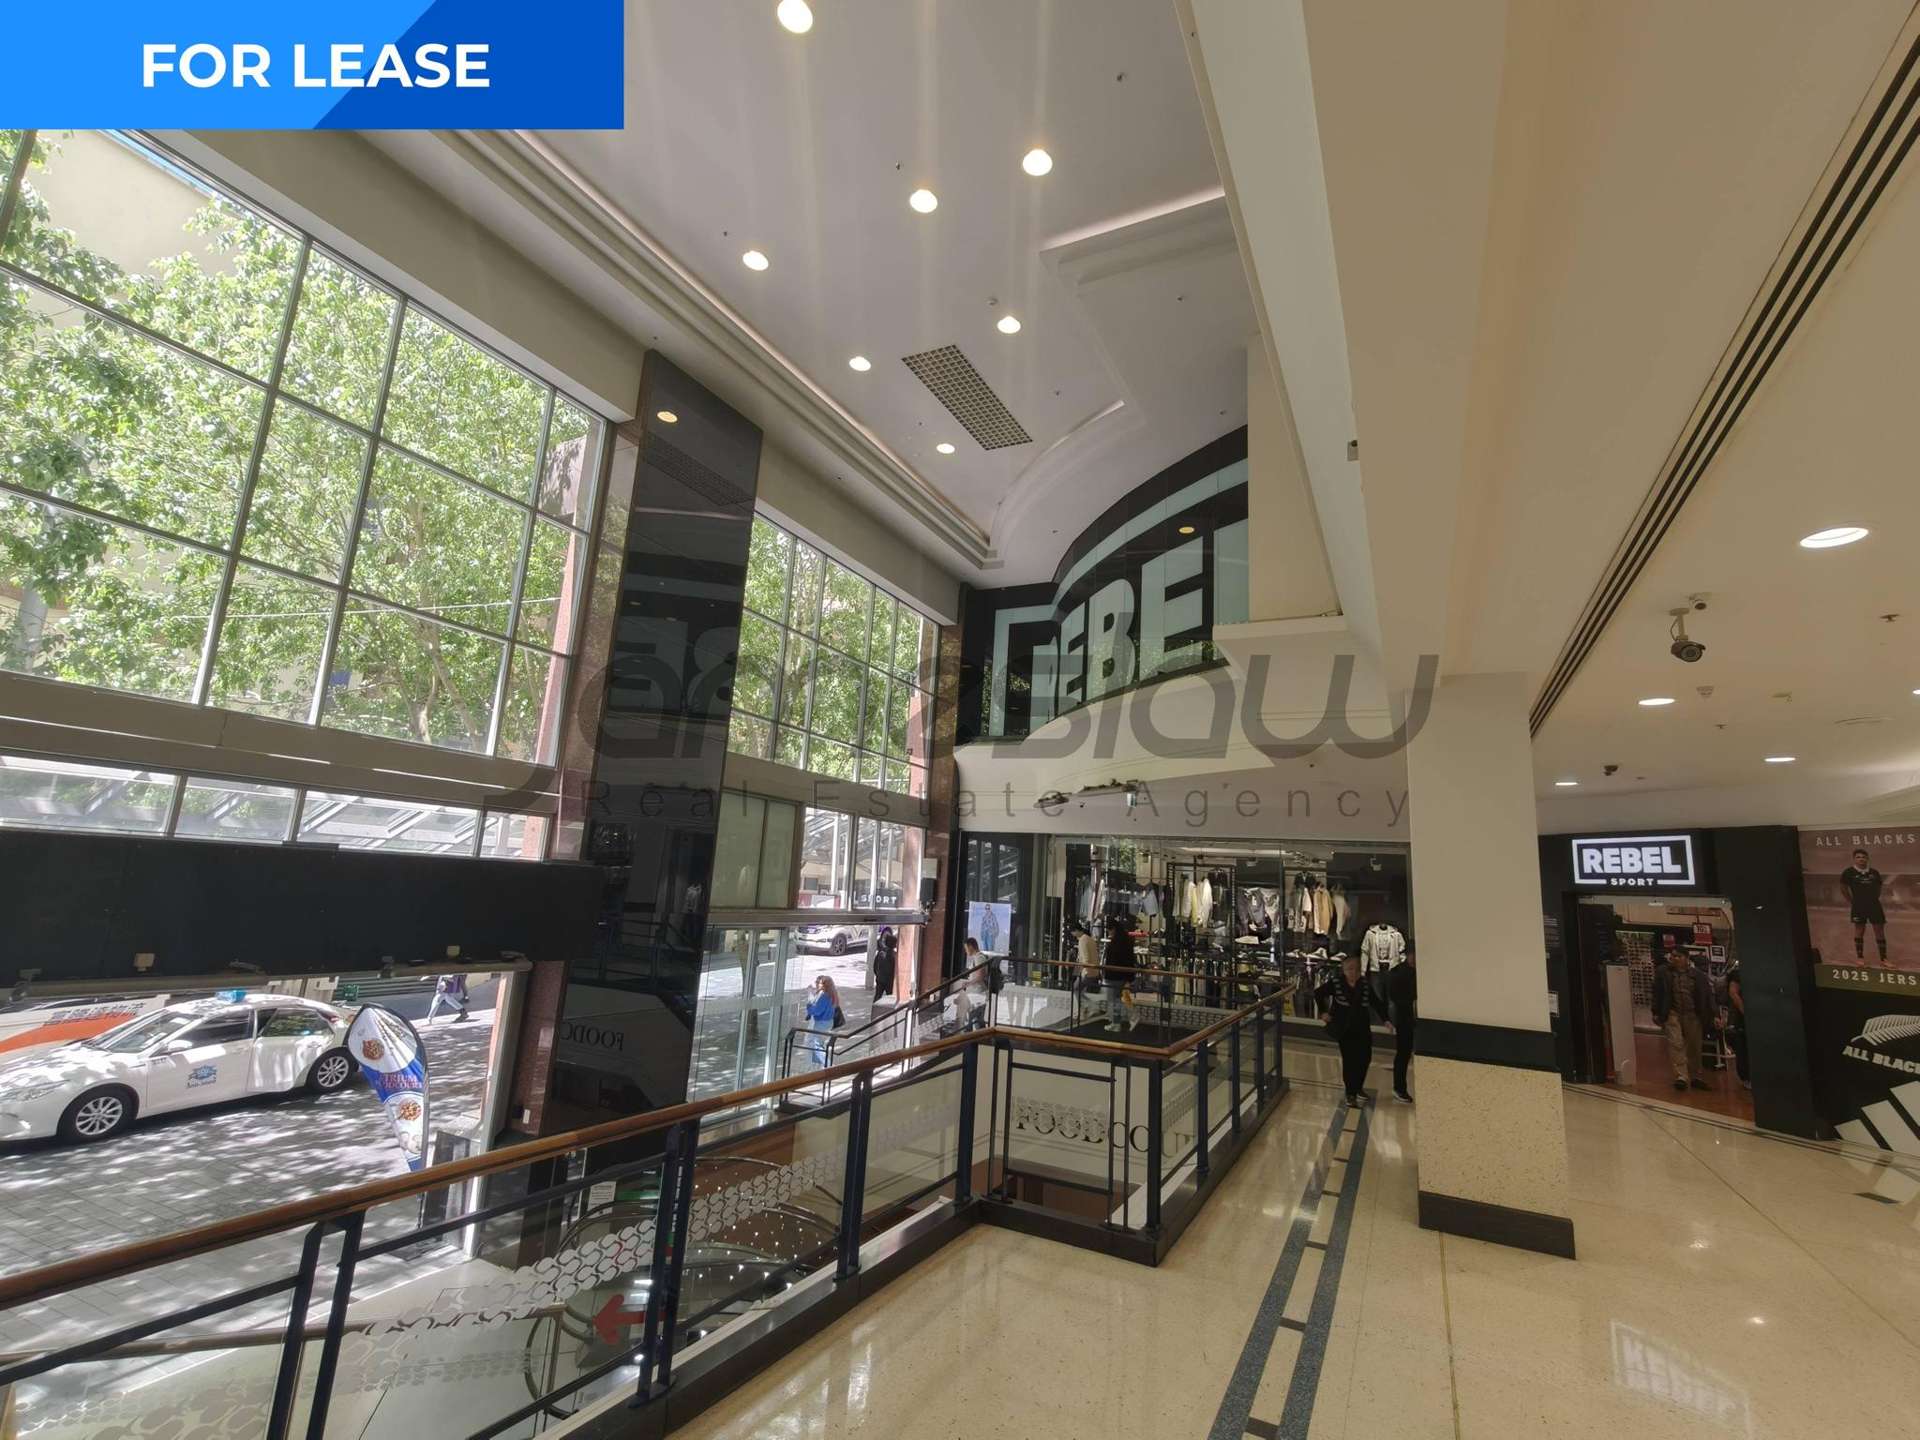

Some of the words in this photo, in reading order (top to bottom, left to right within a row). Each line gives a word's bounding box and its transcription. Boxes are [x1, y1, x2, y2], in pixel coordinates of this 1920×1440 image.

[1815, 836, 1841, 846] ALL
[1852, 833, 1916, 845] BLACKS
[1582, 846, 1682, 873] REBEL
[1610, 878, 1654, 886] SPORT
[1832, 969, 1869, 982] 2025
[1842, 1045, 1869, 1061] ALL
